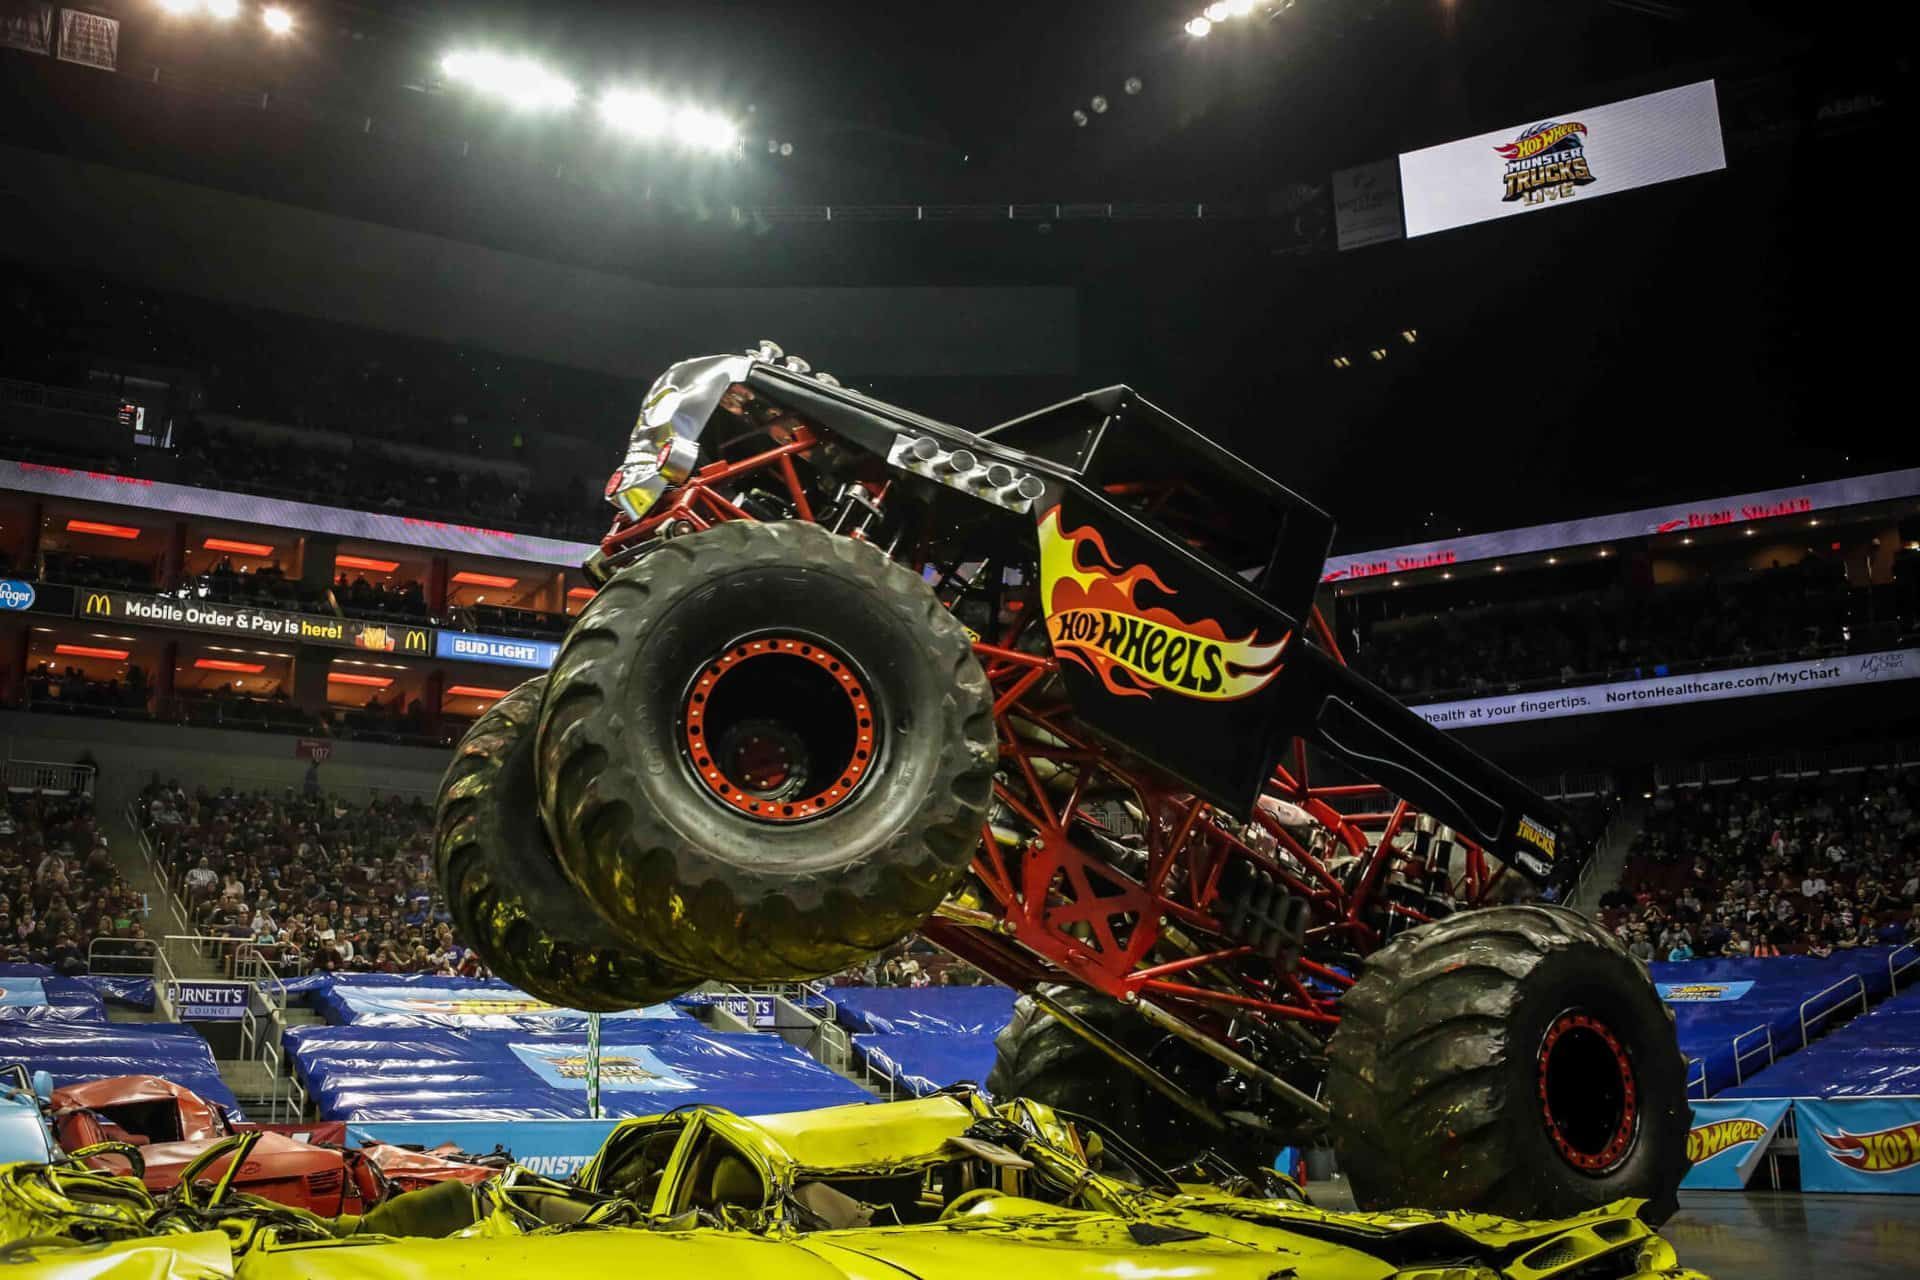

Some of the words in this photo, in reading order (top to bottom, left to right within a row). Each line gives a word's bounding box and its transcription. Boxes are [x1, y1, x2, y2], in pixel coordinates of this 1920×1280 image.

[1505, 148, 1582, 172] MONSTER
[1505, 158, 1588, 197] TRUCKS
[1522, 182, 1575, 206] LIVE
[126, 601, 183, 621] Mobile
[186, 608, 234, 627] Order
[236, 614, 249, 629] &
[252, 616, 283, 635] Pay
[285, 619, 299, 634] is
[302, 621, 343, 640] here!
[455, 640, 488, 655] BUD
[490, 644, 536, 661] LIGHT
[1606, 665, 1841, 703] NortonHealthcare.com/MyChart
[1424, 709, 1465, 723] health
[1469, 708, 1482, 719] at
[1487, 704, 1517, 720] your
[1520, 695, 1591, 714] fingertips.
[1516, 820, 1555, 859] TRUCKS
[168, 987, 245, 1003] BURNETT'S
